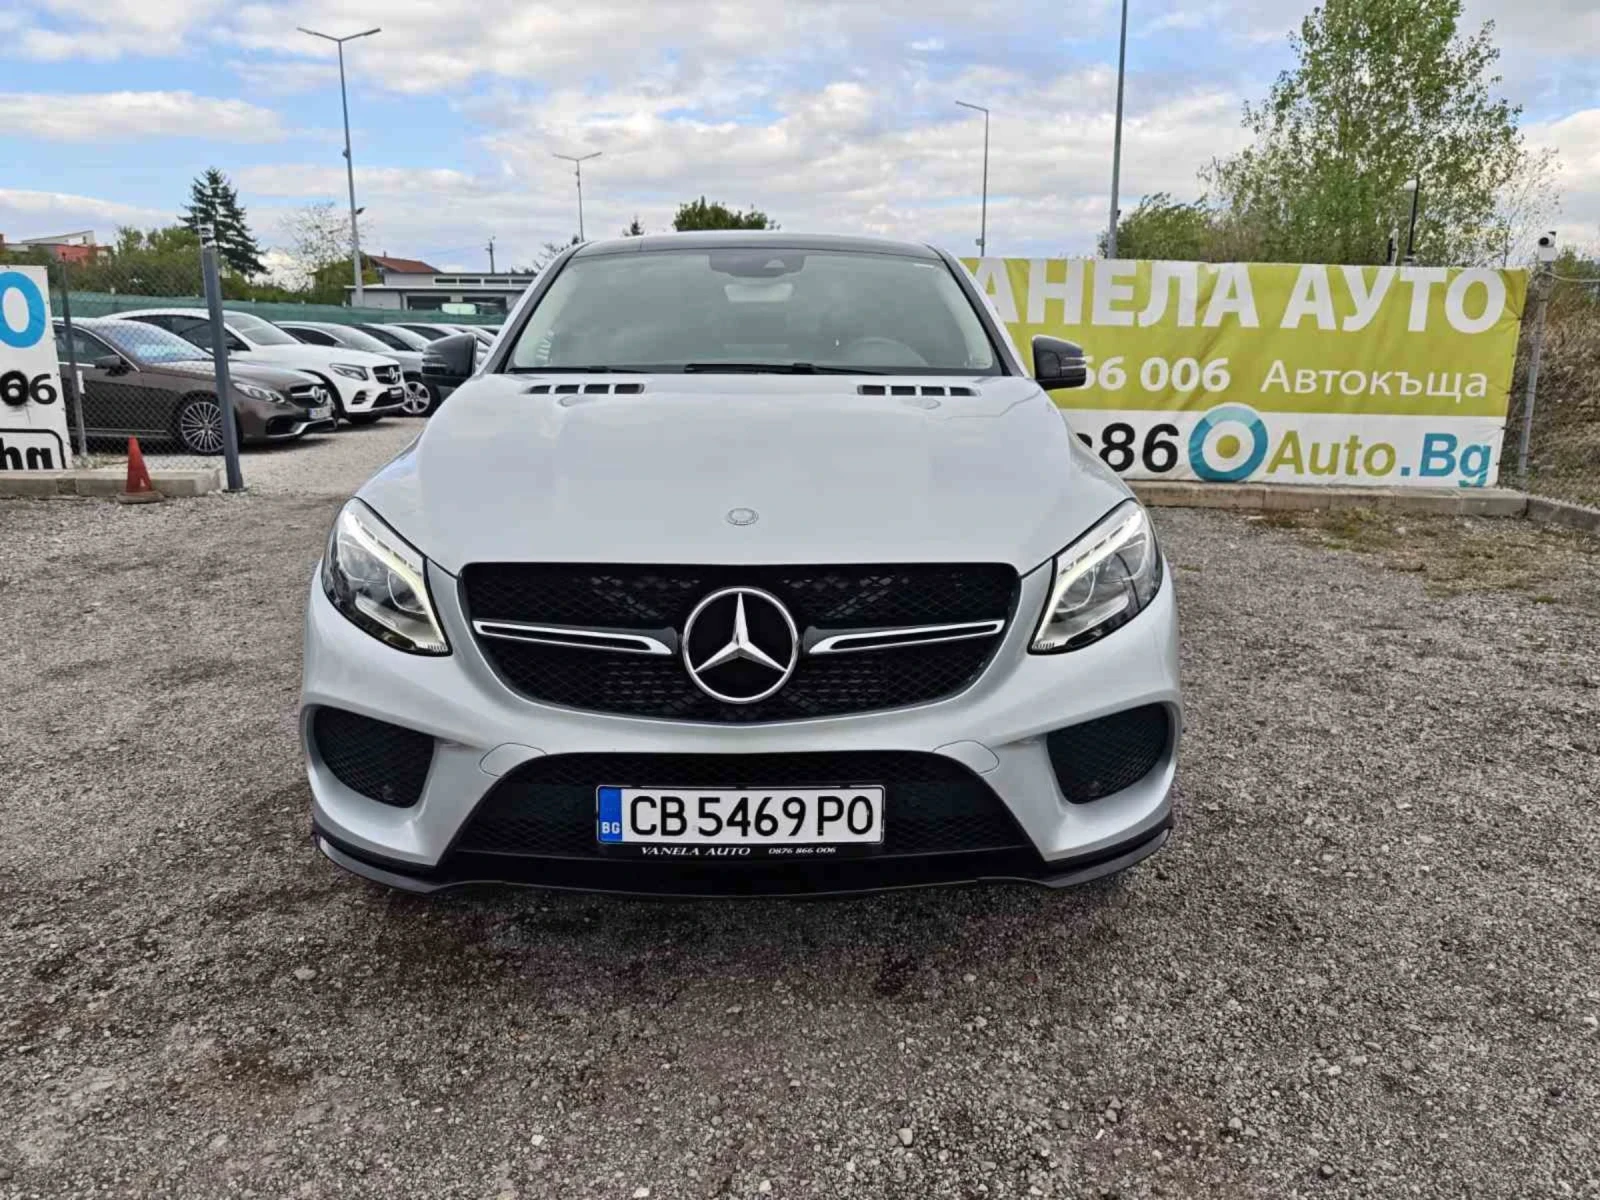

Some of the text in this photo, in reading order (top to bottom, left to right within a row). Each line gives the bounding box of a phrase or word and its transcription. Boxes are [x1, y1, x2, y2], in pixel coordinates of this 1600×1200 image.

[1279, 263, 1507, 334] АУТО
[1139, 356, 1231, 393] 006
[1259, 359, 1489, 404] Автокъща
[1077, 422, 1180, 473] 86
[601, 821, 621, 834] BG
[640, 846, 700, 857] VANELA
[705, 846, 751, 857] AUTO
